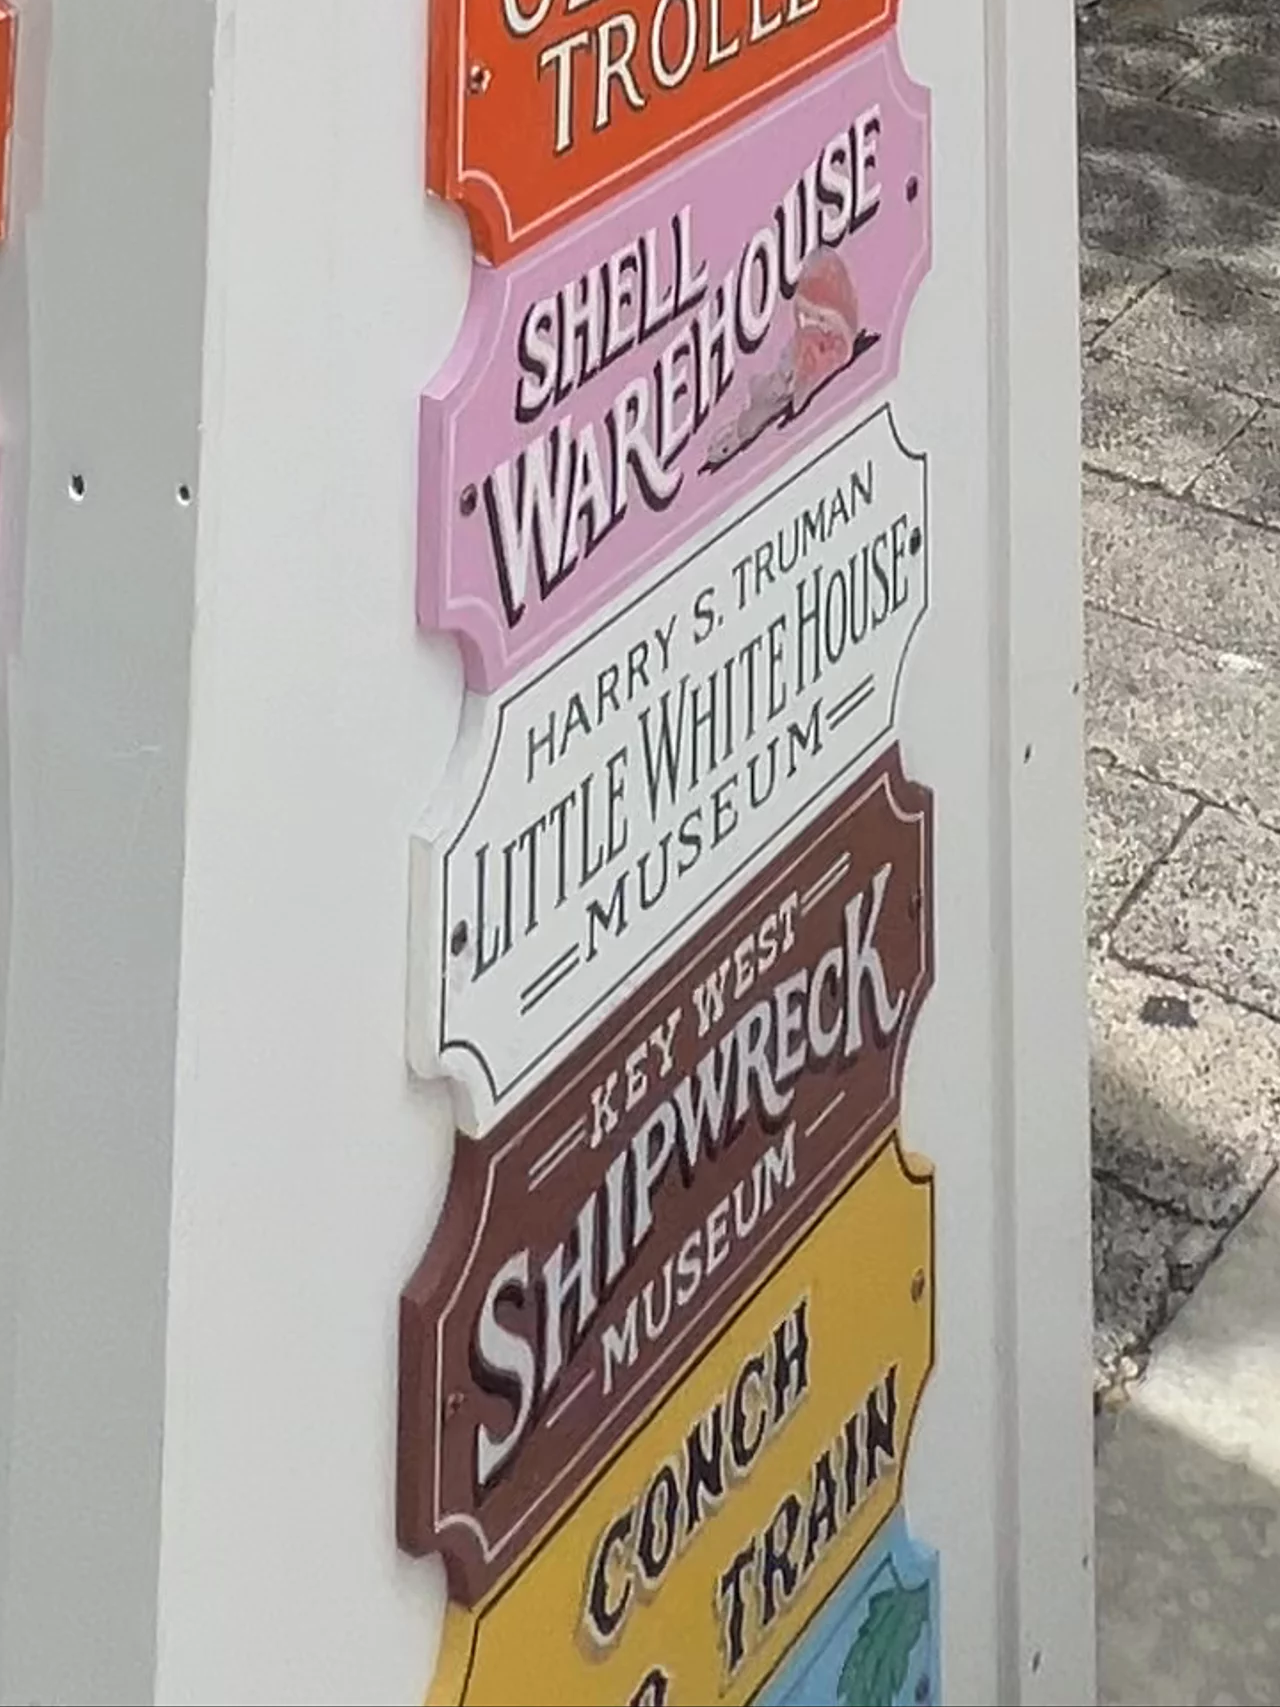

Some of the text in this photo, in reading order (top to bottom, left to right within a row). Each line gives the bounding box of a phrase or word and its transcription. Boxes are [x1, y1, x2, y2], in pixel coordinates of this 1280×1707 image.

[483, 103, 884, 628] WAREHOUSE
[516, 206, 707, 424] SHELL
[471, 513, 911, 983] LITTLE WHITE HOUSE
[526, 460, 875, 785] HARRY S. TRUMAN
[584, 697, 825, 963] MUSEUM
[475, 864, 907, 1488] SHIPWRECK
[587, 903, 802, 1150] KEY WEST
[600, 1143, 796, 1396] MUSEUM
[589, 1296, 810, 1637] CONCH
[720, 1364, 898, 1673] TRAIN
